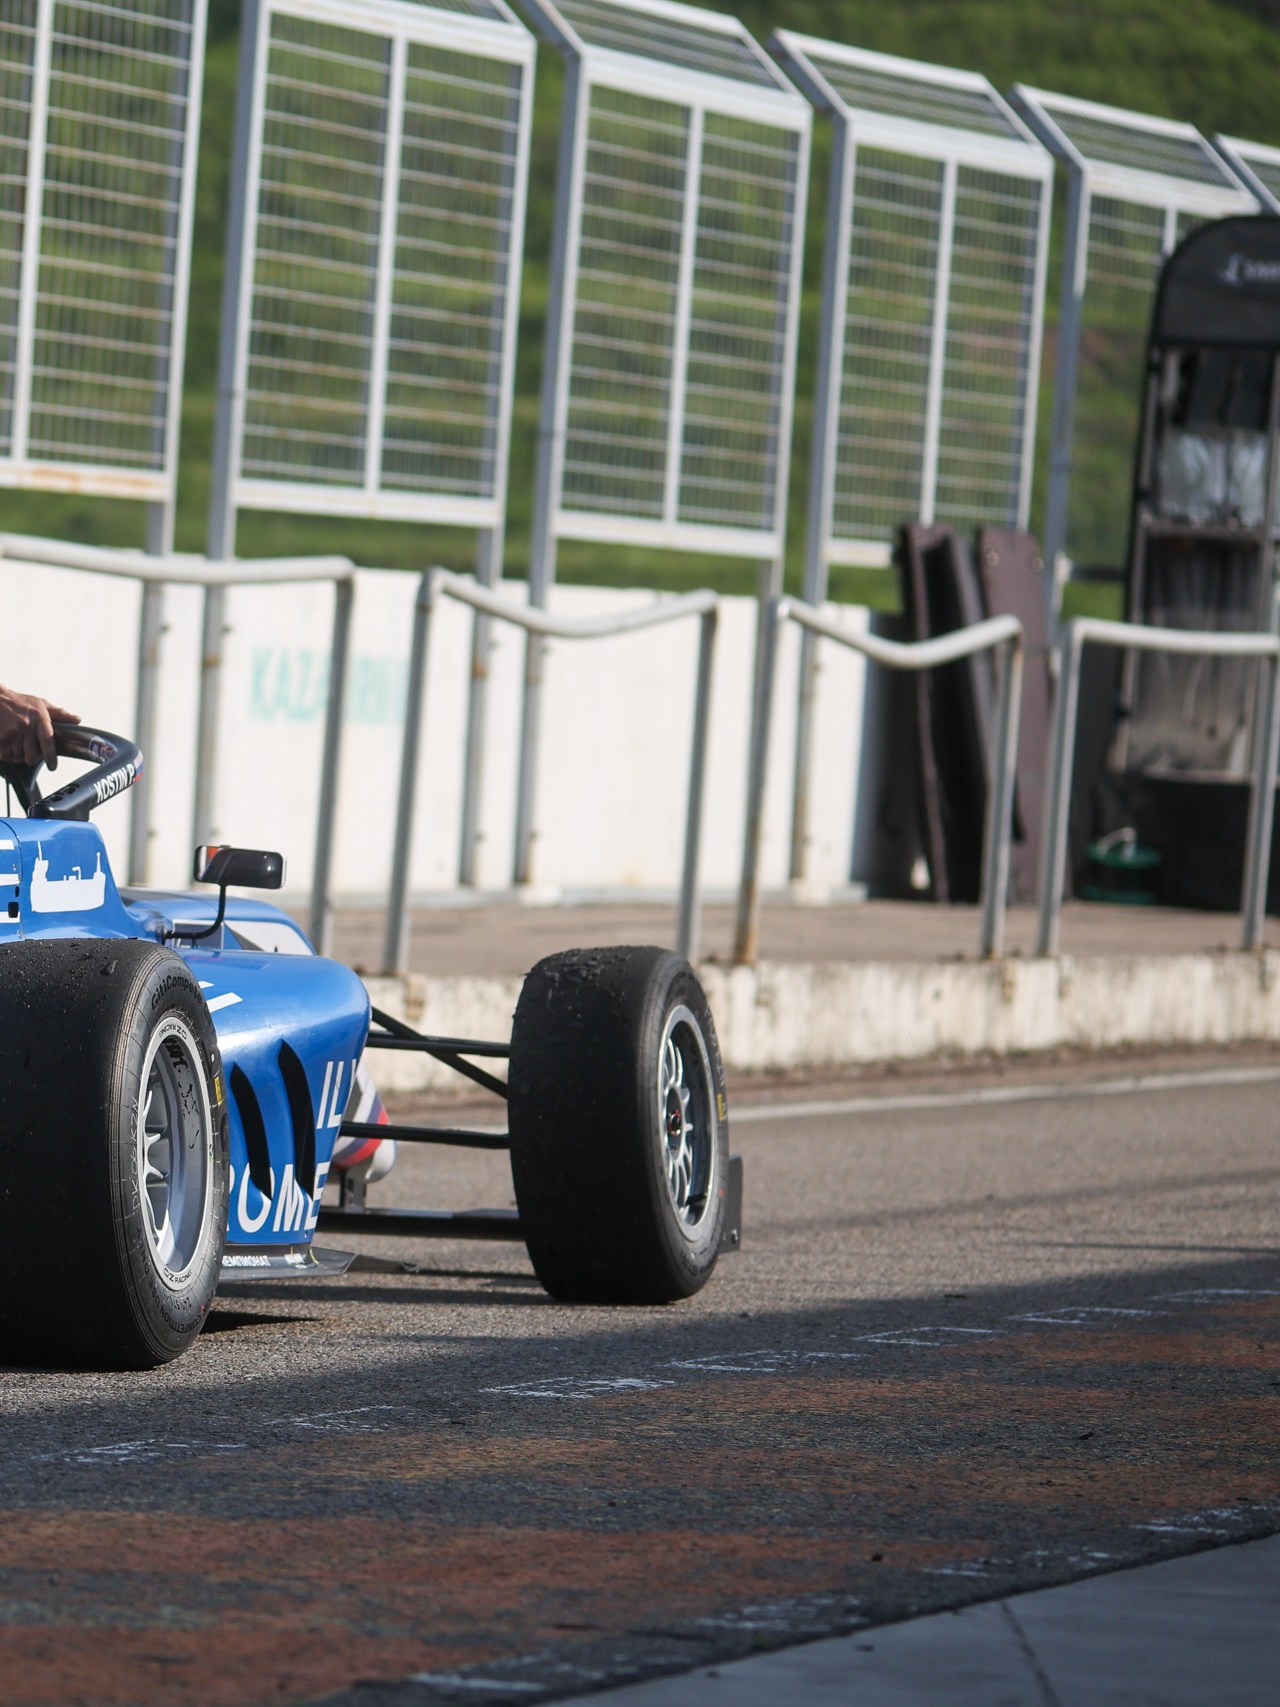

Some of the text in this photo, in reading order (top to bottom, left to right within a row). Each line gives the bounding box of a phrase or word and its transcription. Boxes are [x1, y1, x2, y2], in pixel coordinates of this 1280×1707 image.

[93, 766, 128, 803] KOSTIN
[151, 974, 203, 1011] GitiCompete
[222, 1255, 271, 1267] ЕМПИОНАТ
